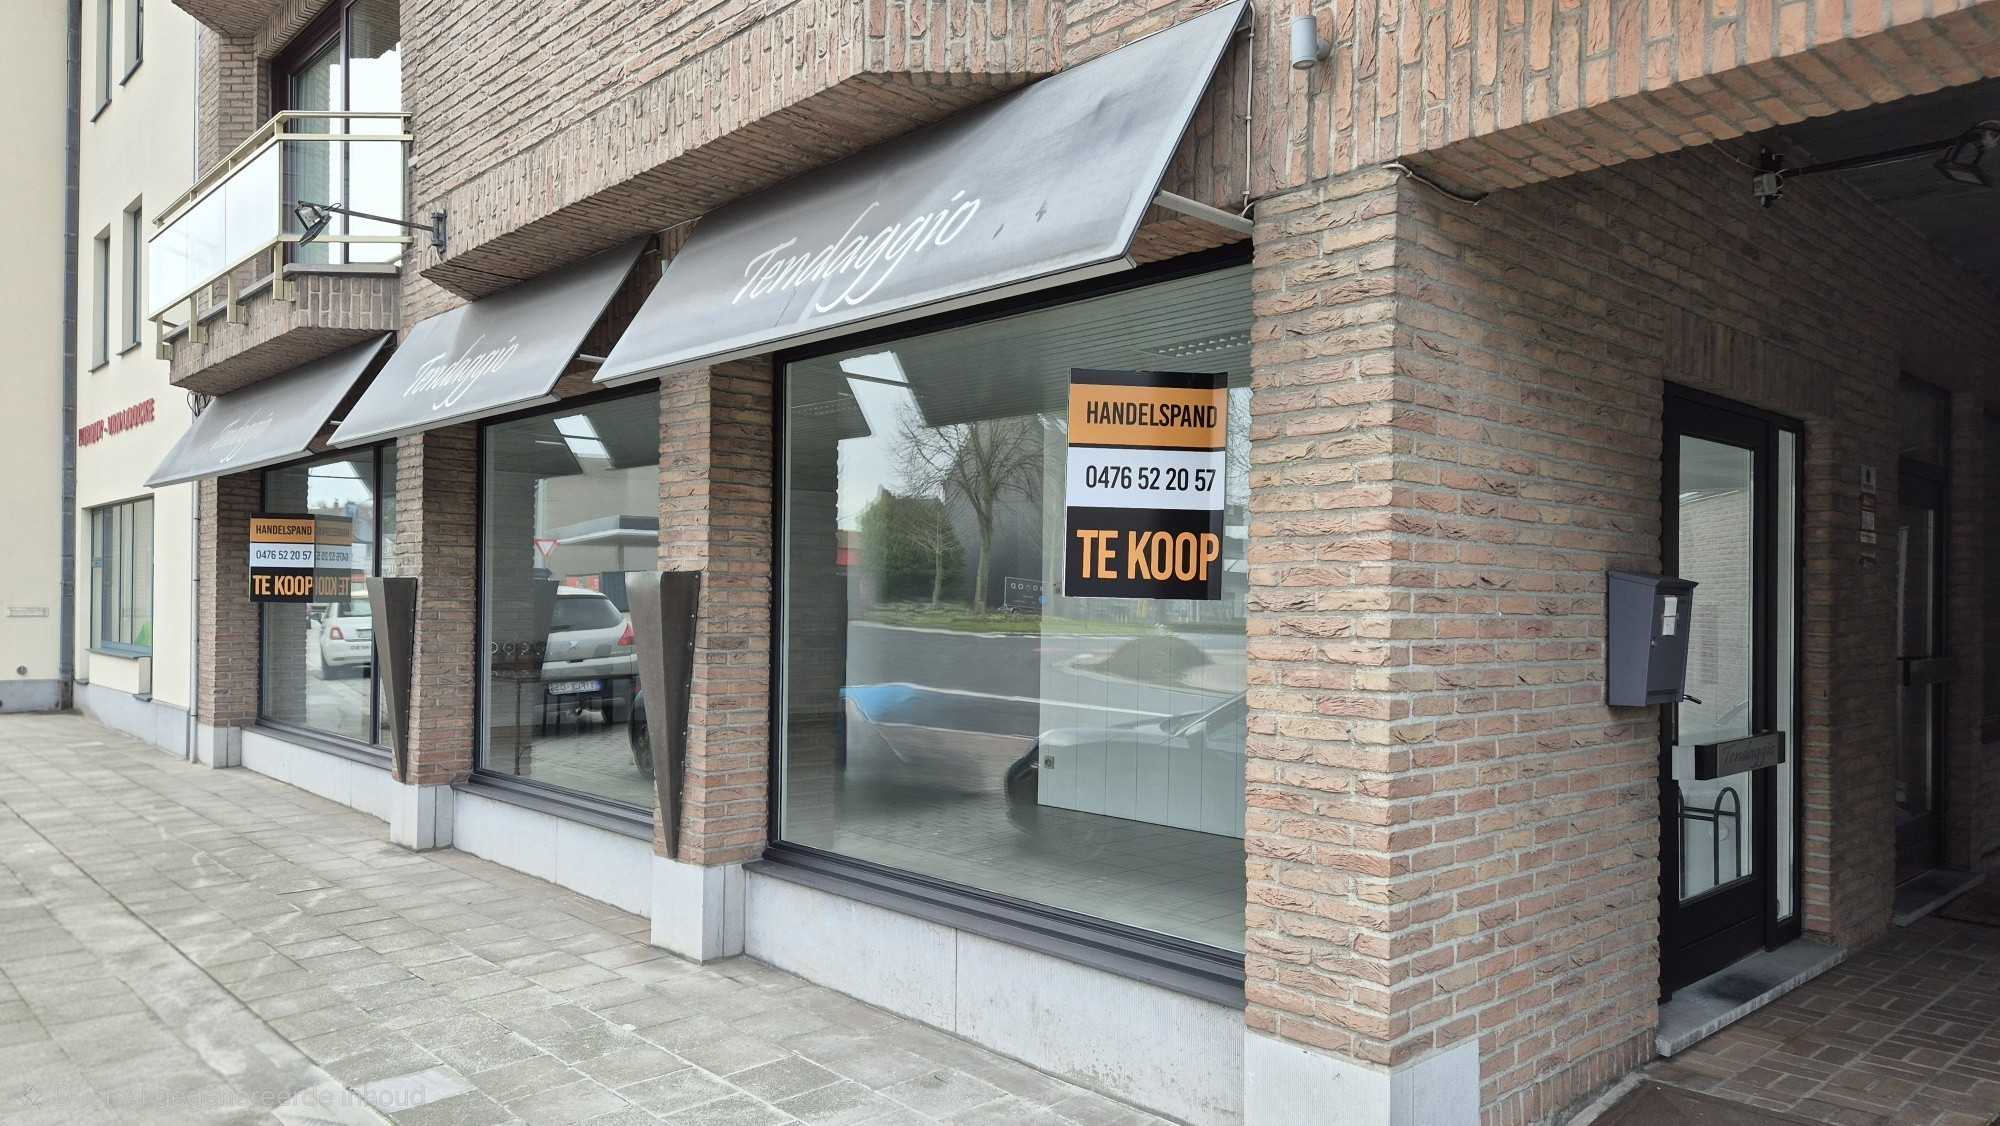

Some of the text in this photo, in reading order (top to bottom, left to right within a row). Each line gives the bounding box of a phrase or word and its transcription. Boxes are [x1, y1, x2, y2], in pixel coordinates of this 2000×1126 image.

[731, 190, 981, 313] Tendaggio
[403, 334, 520, 411] Tendaggio
[1086, 400, 1218, 429] HANDELSPAND
[1085, 464, 1217, 492] 0476 52 20 57
[255, 524, 313, 536] HANDELSPAND
[255, 549, 277, 561] 0476
[278, 550, 288, 561] 52
[290, 550, 300, 561] 20
[302, 550, 312, 561] 57
[1076, 529, 1220, 582] TE KOOP
[252, 574, 313, 596] TE KOOP
